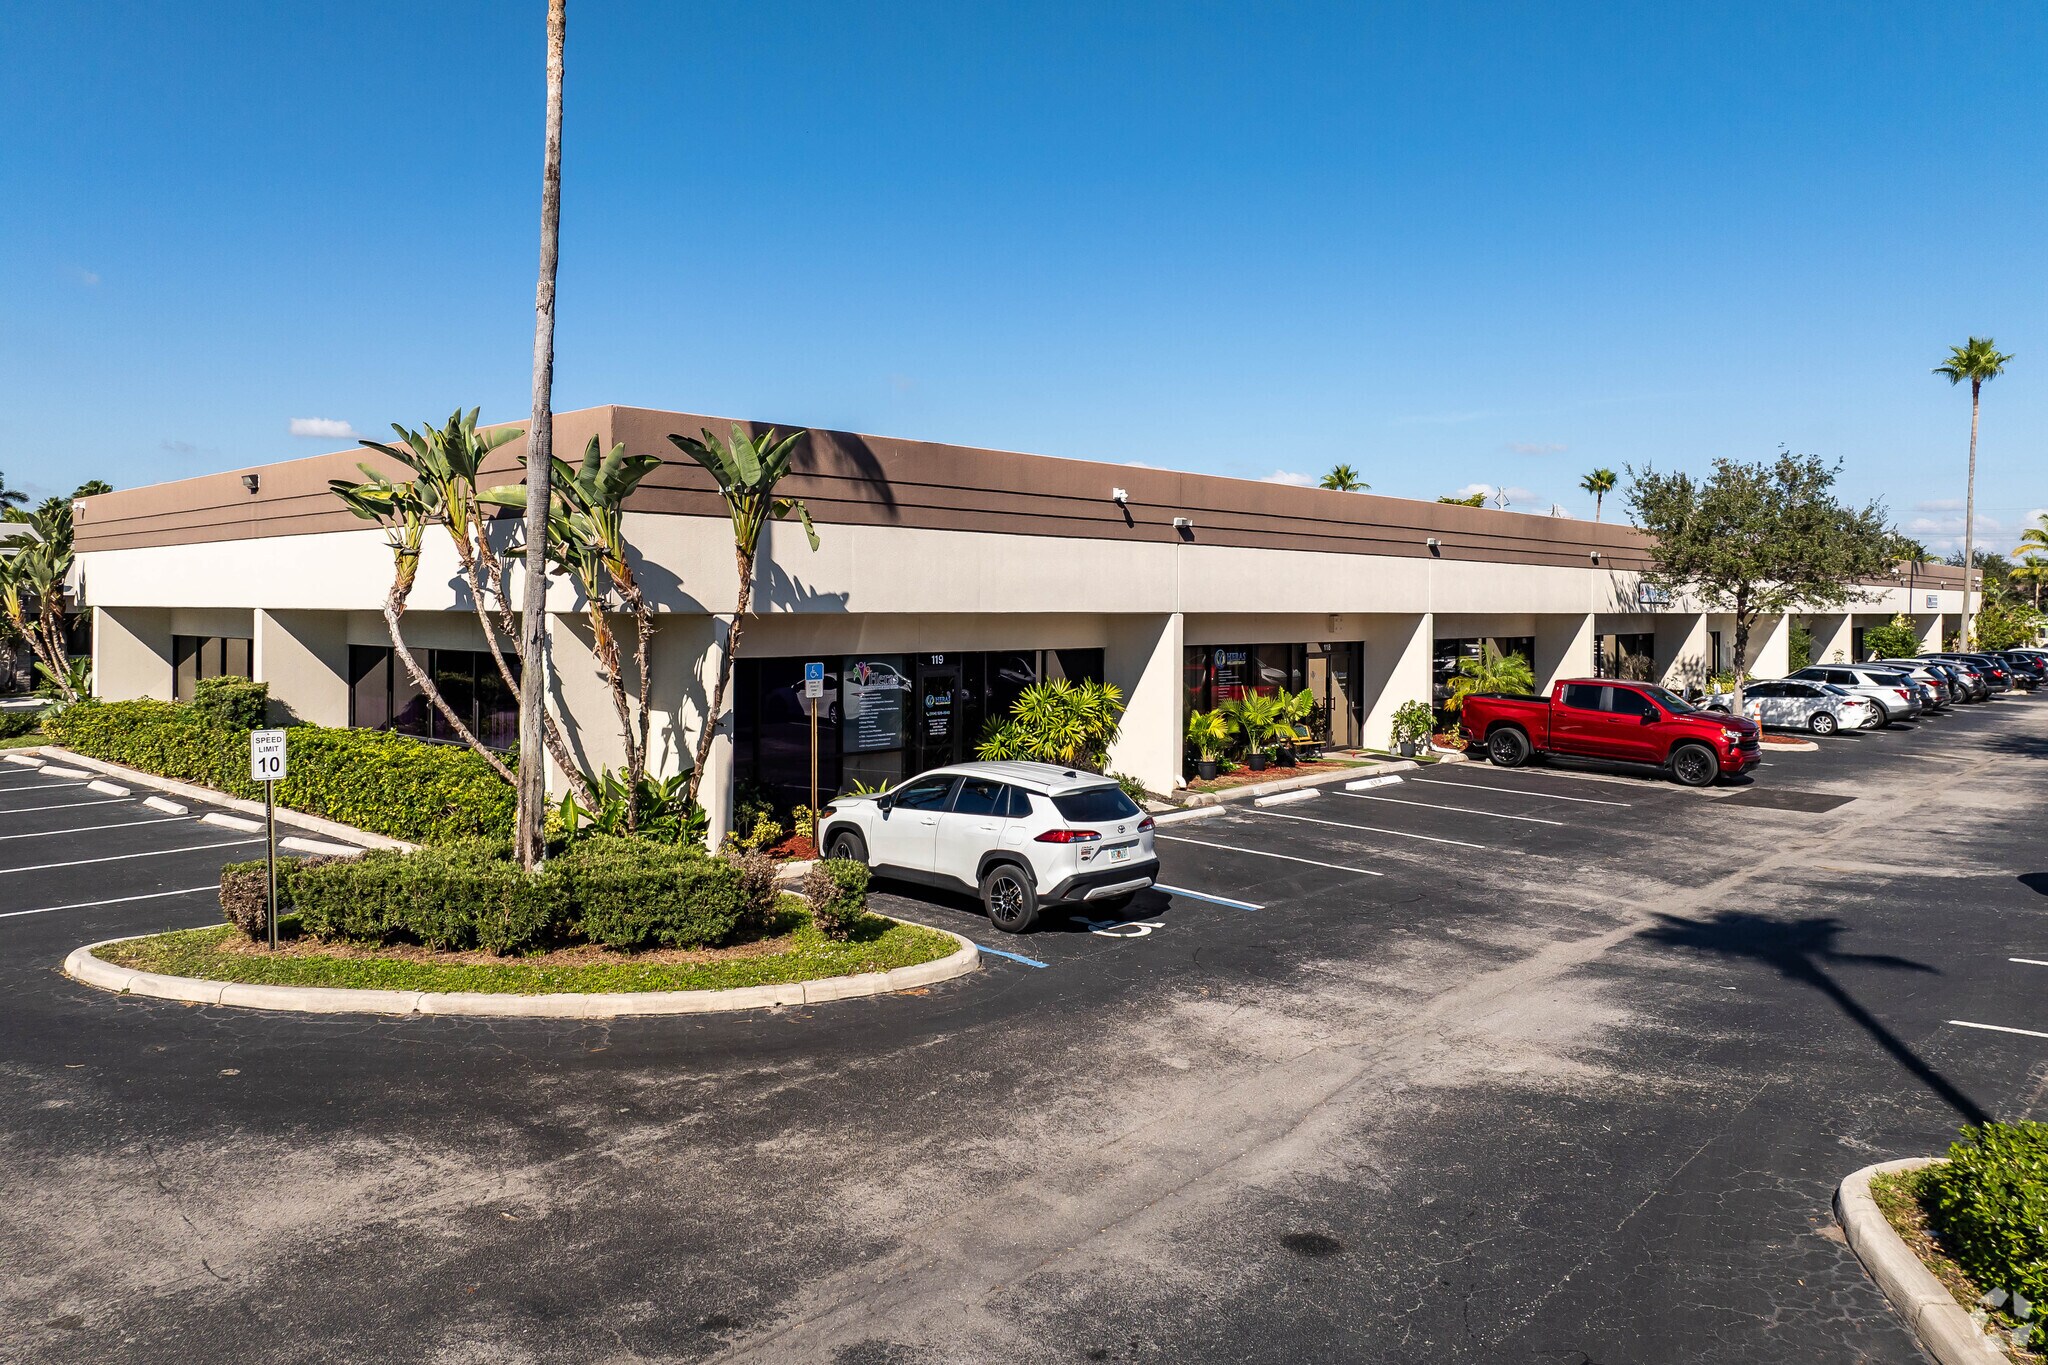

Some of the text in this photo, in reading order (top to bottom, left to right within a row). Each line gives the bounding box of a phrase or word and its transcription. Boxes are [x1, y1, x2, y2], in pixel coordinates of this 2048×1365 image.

[931, 654, 944, 665] 119
[868, 672, 899, 686] Heras
[255, 736, 282, 744] SPEED
[258, 757, 280, 773] 10
